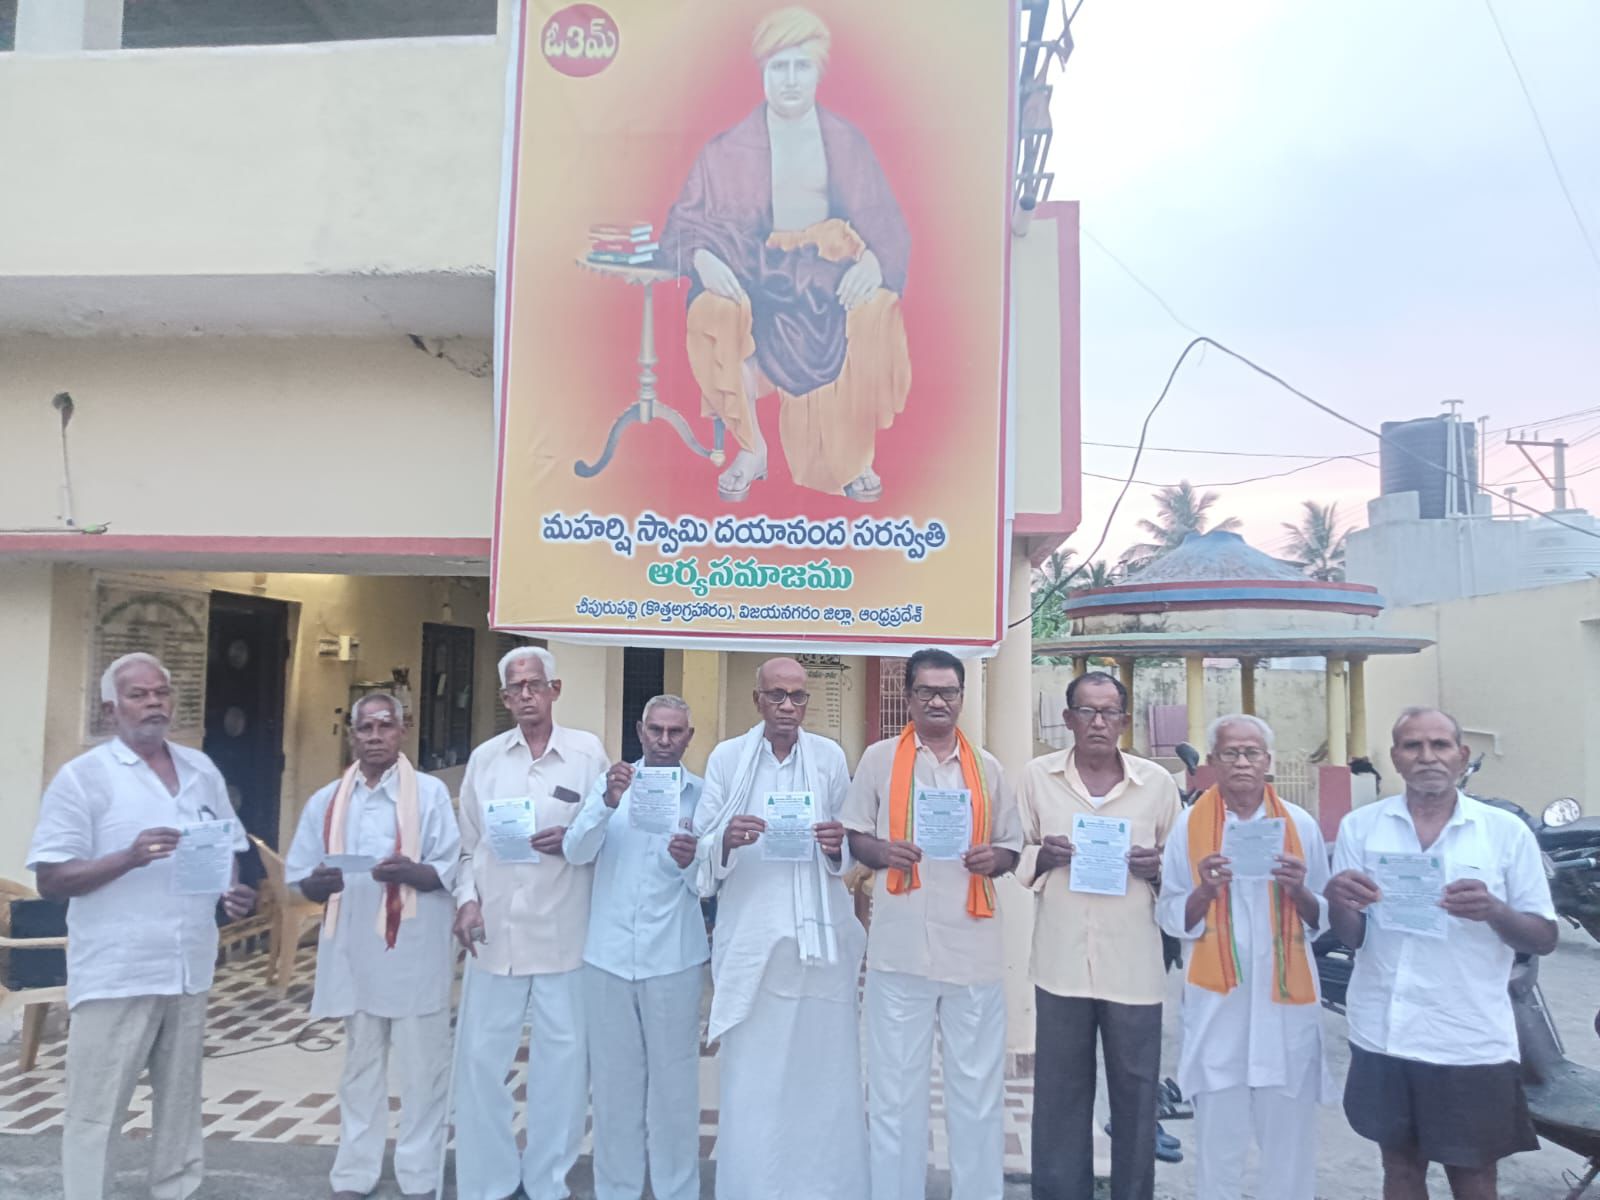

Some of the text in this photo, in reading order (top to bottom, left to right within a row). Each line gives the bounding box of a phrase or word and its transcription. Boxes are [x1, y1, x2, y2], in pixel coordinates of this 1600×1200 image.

[543, 513, 946, 559] మహర్షి స్వామి దయానంద సరస్వతి
[576, 597, 637, 620] చీపురుపల్లి
[739, 604, 820, 621] విజయనగరం
[859, 604, 923, 627] ఆంధ్రప్రదేశ్
